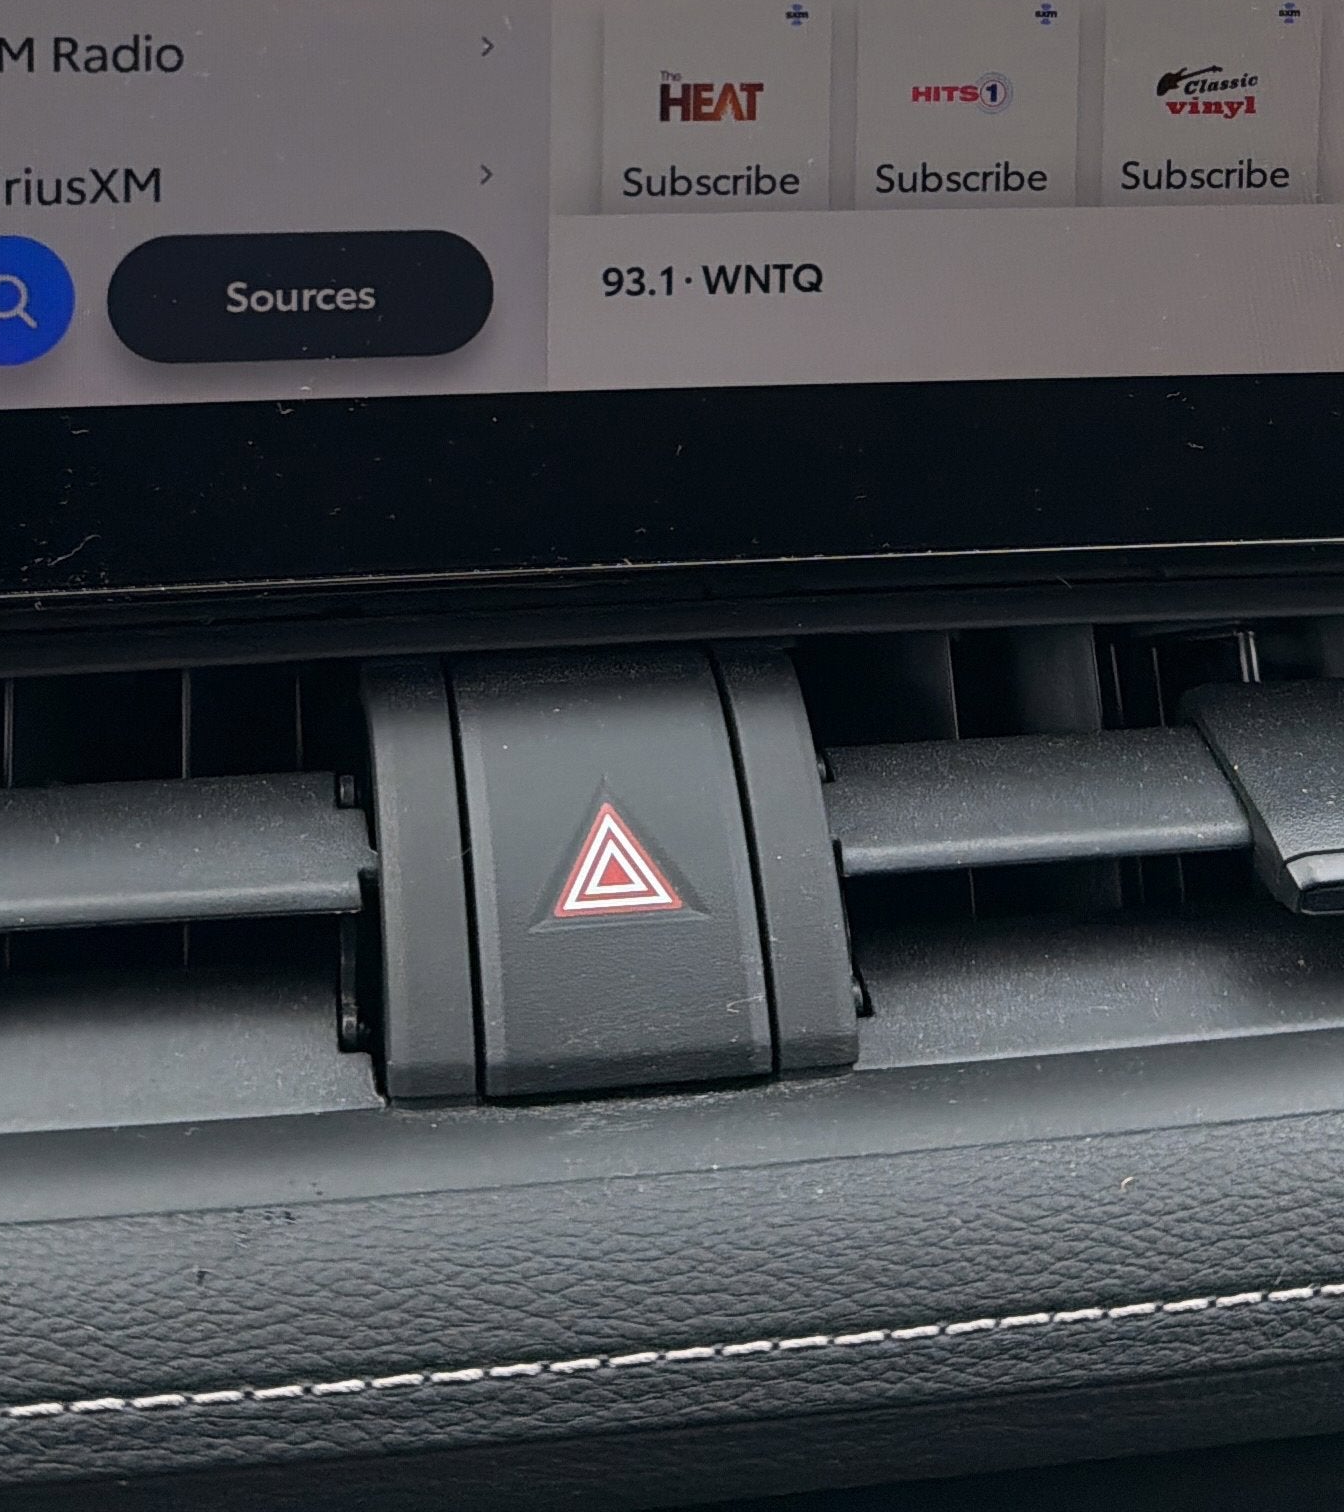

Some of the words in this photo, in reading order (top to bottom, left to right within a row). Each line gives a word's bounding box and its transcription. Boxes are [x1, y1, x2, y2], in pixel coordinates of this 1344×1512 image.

[52, 33, 185, 74] Radio
[1183, 73, 1259, 95] Classic
[659, 82, 765, 122] HEAT
[1165, 95, 1257, 120] vinyl
[622, 164, 801, 198] Subscribe
[875, 160, 1049, 194] Subscribe
[1120, 158, 1291, 191] Subscribe
[601, 265, 674, 297] 93.1
[701, 262, 824, 296] WNTQ
[225, 281, 377, 314] Sources
